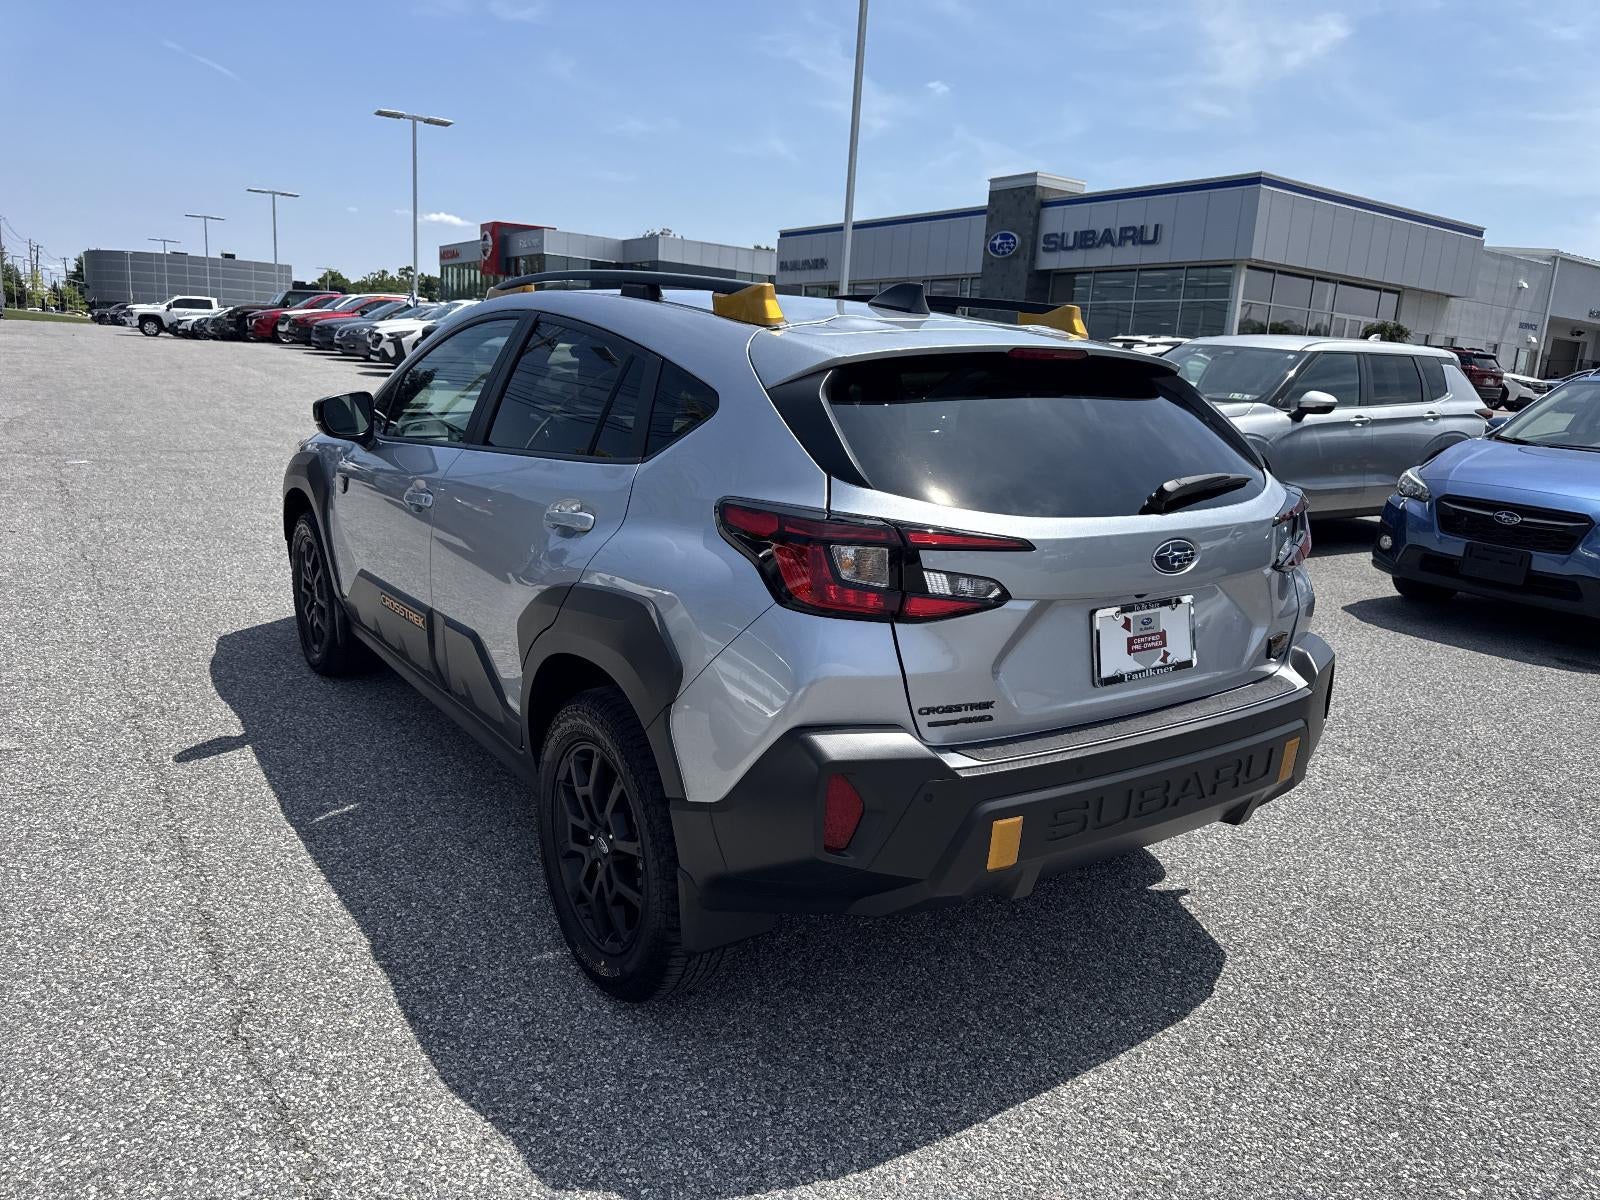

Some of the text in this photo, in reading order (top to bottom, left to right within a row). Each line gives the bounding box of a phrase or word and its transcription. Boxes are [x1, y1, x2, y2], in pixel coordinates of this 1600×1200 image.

[1042, 224, 1161, 252] SUBARU
[1518, 322, 1538, 331] SERVICE
[381, 594, 425, 629] CROSSTREK
[1131, 640, 1163, 651] PRE-OWNED
[1133, 634, 1160, 645] CERTIFIED
[1124, 665, 1175, 681] Faulkner
[918, 701, 996, 716] CROSSTREK
[1047, 748, 1275, 842] SUBARU
